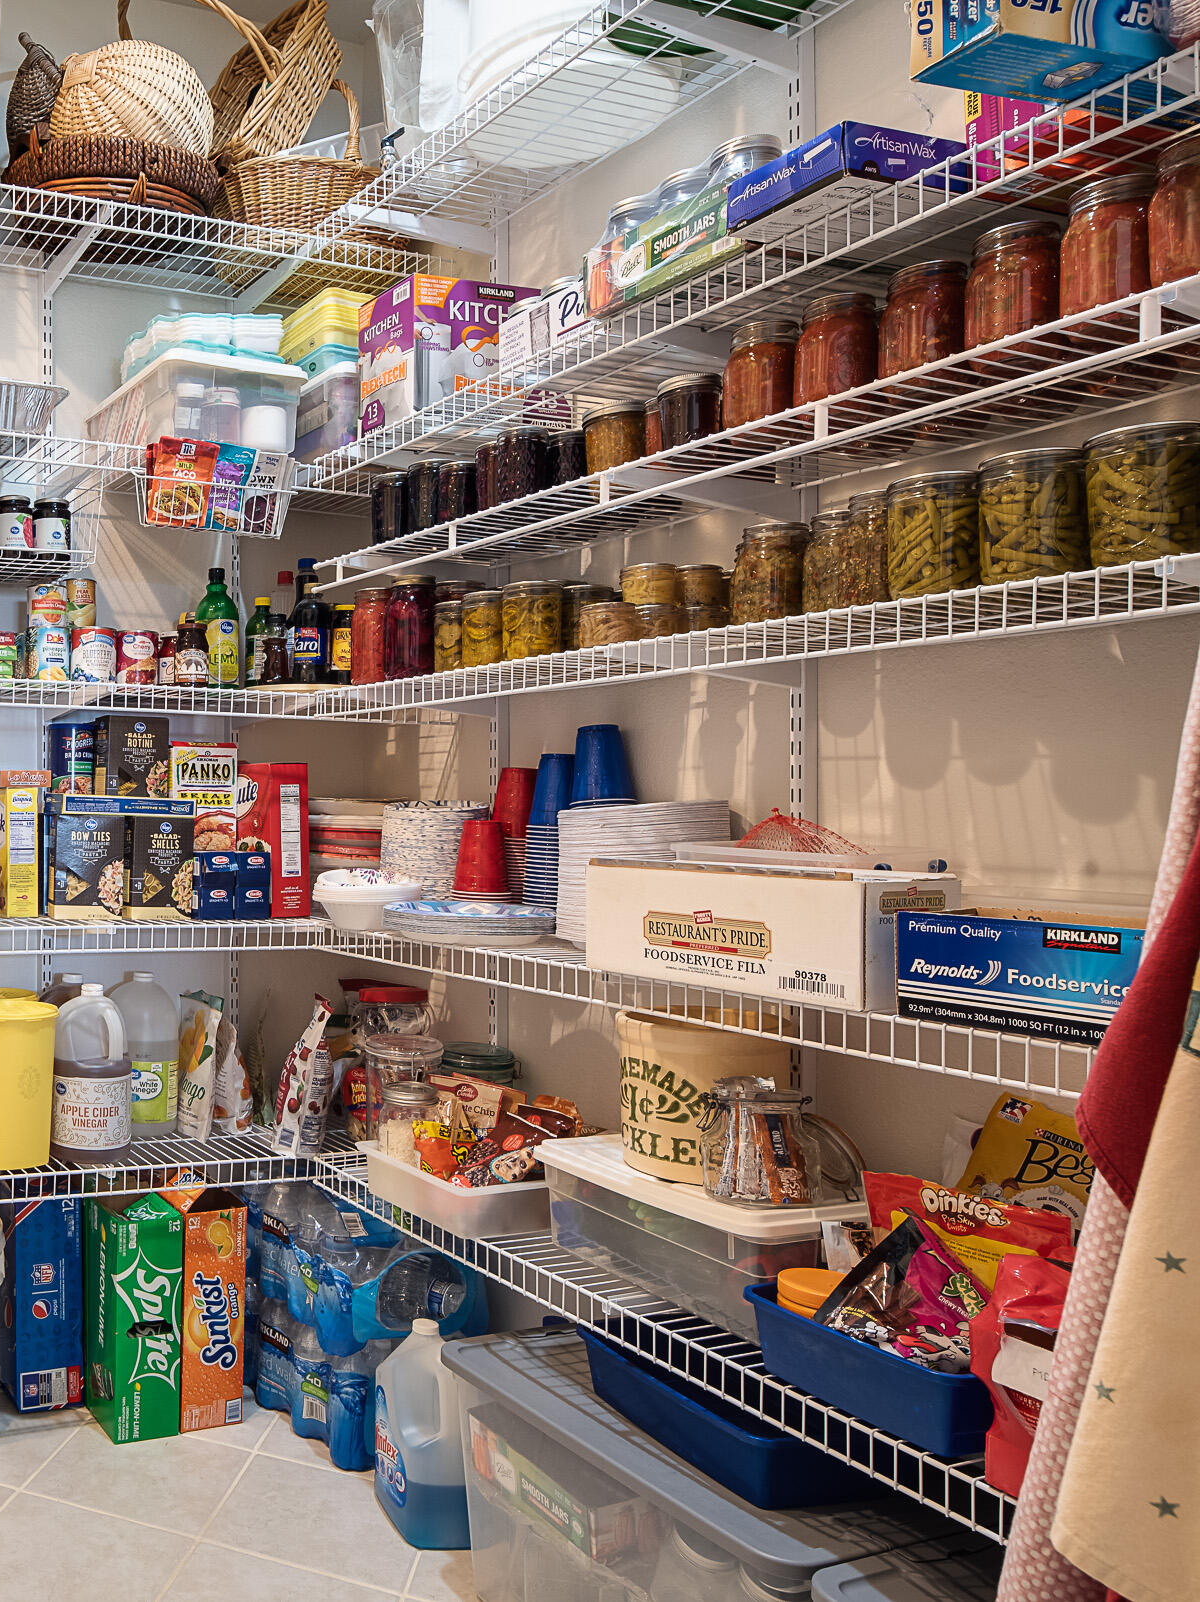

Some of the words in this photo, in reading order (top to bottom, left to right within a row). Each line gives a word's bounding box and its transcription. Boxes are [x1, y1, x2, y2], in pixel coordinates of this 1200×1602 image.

[854, 131, 937, 161] ArtisanWax
[730, 164, 796, 207] ArtisanWax
[654, 226, 690, 254] SMOOTH
[693, 212, 716, 238] JARS
[479, 287, 515, 298] KIRKLAND
[449, 300, 509, 325] KITCH
[364, 311, 399, 344] KITCHEN
[172, 468, 196, 479] TACO
[178, 462, 192, 470] MILD
[47, 634, 64, 643] Dole
[208, 653, 239, 666] LEMON
[127, 738, 153, 749] ROTINI
[180, 762, 231, 781] PANKO
[180, 792, 231, 800] BREAD
[71, 831, 90, 841] BOW
[92, 831, 111, 841] TIES
[151, 839, 180, 849] SHELLS
[648, 920, 727, 943] RESTAURANT'S
[908, 921, 957, 935] Premium
[960, 924, 1001, 942] Quality
[1047, 928, 1119, 945] KIRKLAND
[644, 948, 732, 971] FOODSERVICE
[795, 970, 827, 982] 90378
[910, 958, 980, 980] Reynolds
[935, 1006, 966, 1020] (304mm
[974, 1011, 1006, 1026] 304.8m)
[1008, 1017, 1028, 1028] 1000
[1029, 1020, 1042, 1031] SQ
[1043, 1022, 1053, 1032] FT
[1055, 1025, 1069, 1035] (12
[1071, 1026, 1080, 1036] in
[621, 1057, 710, 1118] MEMADE
[61, 1104, 92, 1117] APPLE
[93, 1106, 119, 1117] CIDER
[473, 1105, 495, 1117] Chip
[72, 1117, 108, 1128] VINEGAR
[1043, 1132, 1084, 1153] PURINA
[921, 1188, 1009, 1227] Oinkies
[941, 1214, 956, 1225] Pig
[957, 1215, 976, 1228] Skin
[947, 1224, 967, 1233] twists
[41, 1265, 51, 1282] NFL
[300, 1264, 312, 1278] 40
[938, 1294, 957, 1310] chewy
[957, 1305, 972, 1318] Trea
[194, 1272, 238, 1370] Sunkist
[305, 1373, 322, 1388] 40
[133, 1391, 141, 1438] LEMON-LIME
[521, 1478, 550, 1508] SMOOTH
[552, 1503, 569, 1524] JARS
